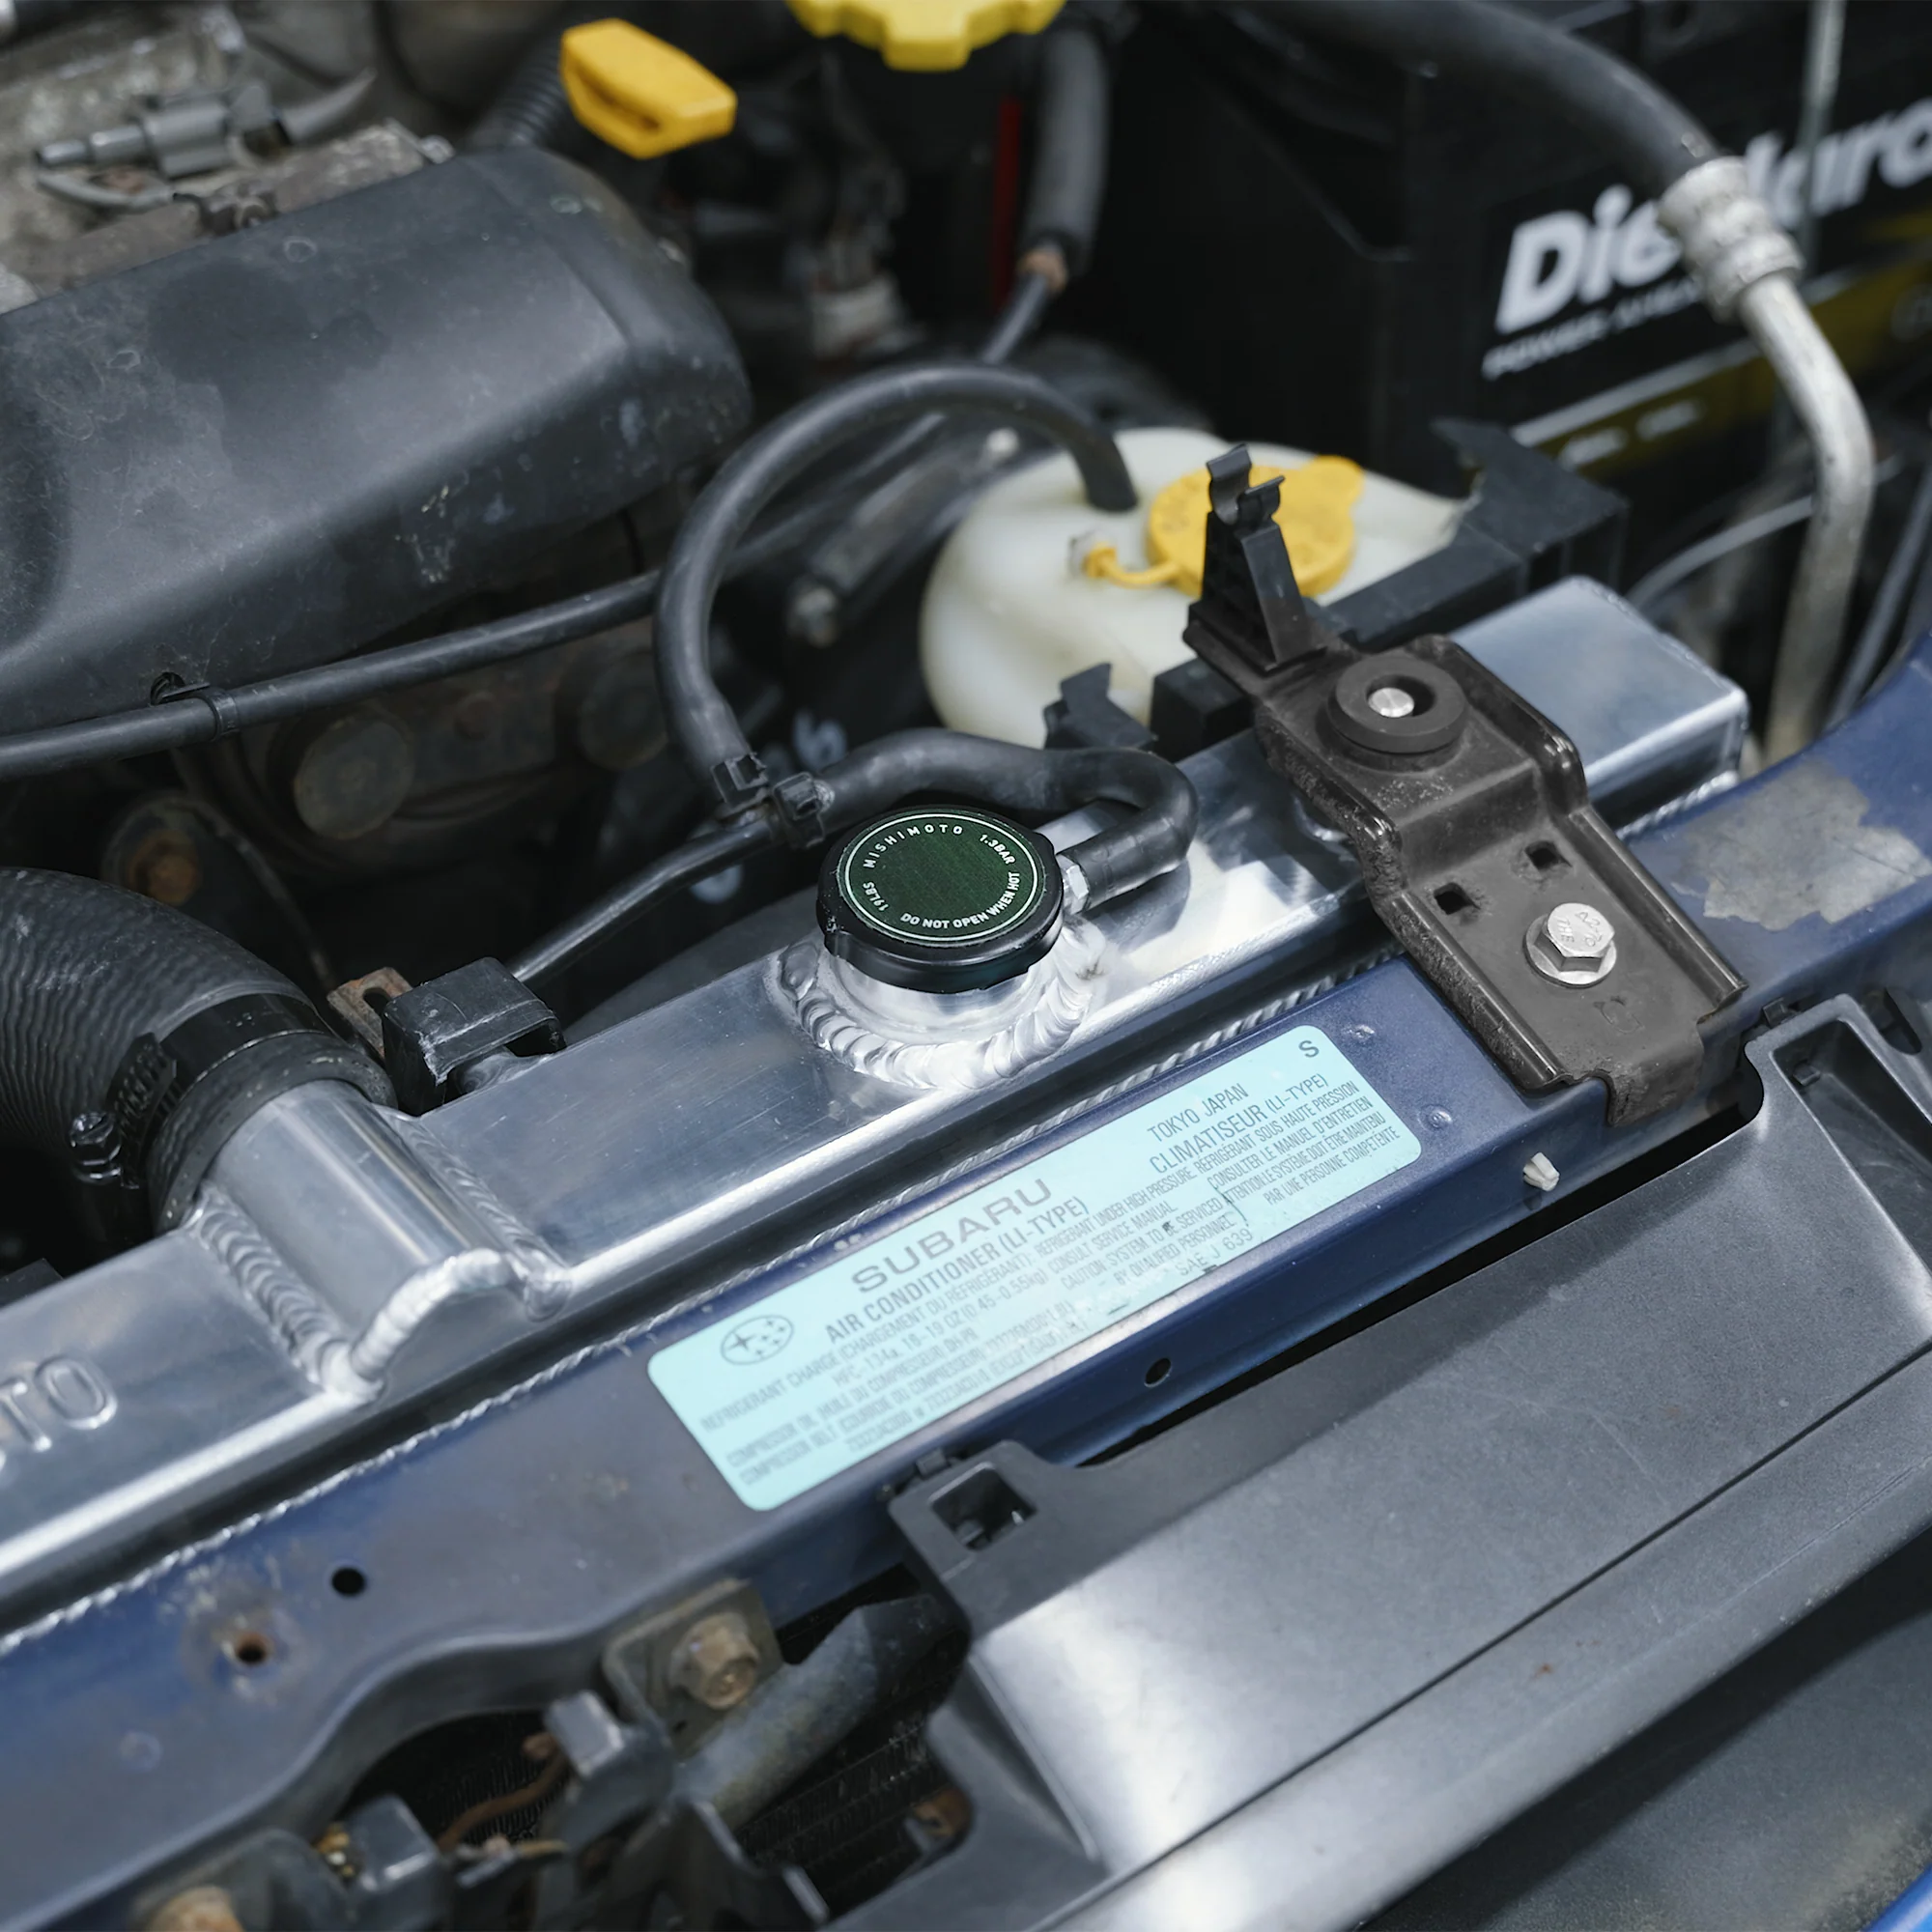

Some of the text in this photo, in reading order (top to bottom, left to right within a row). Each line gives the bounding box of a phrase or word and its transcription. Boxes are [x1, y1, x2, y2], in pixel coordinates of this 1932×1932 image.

[863, 824, 963, 868] MISHIMOTO
[980, 834, 1016, 865] 1.3BAR
[863, 881, 889, 912] 19LBS
[899, 871, 1021, 929] DO NOT OPEN WHEN HOT
[1298, 1039, 1320, 1058] S
[1147, 1083, 1249, 1142] TOKYO JAPAN
[1150, 1073, 1329, 1174] CLIMATISEUR (LI-TYPE)
[1254, 1120, 1285, 1143] SOUS
[1280, 1103, 1317, 1128] HAUTE
[1311, 1080, 1360, 1112] PRESSION
[1305, 1140, 1329, 1160] DOIT
[1342, 1111, 1386, 1141] MAINTENU
[1207, 1095, 1374, 1191] CONSULTER LE MANUEL D'ENTRETIEN
[1263, 1187, 1286, 1206] PAR
[1281, 1177, 1304, 1196] UNE
[1299, 1154, 1348, 1186] PERSONNE
[1093, 1202, 1127, 1227] UNDER
[1122, 1189, 1151, 1210] HIGH
[1105, 1236, 1150, 1266] SYSTEM
[1147, 1228, 1165, 1244] TO
[1175, 1197, 1224, 1229] SERVICED
[851, 1179, 1051, 1293] SUBARU
[1047, 1241, 1094, 1274] CONSULT
[1091, 1221, 1135, 1251] SERVICE
[1176, 1228, 1254, 1277] SAE J 639
[825, 1196, 1090, 1344] AIR CONDITIONER (LI-TYPE)
[1112, 1268, 1129, 1286] BY
[1128, 1242, 1181, 1277] QUALIFIED
